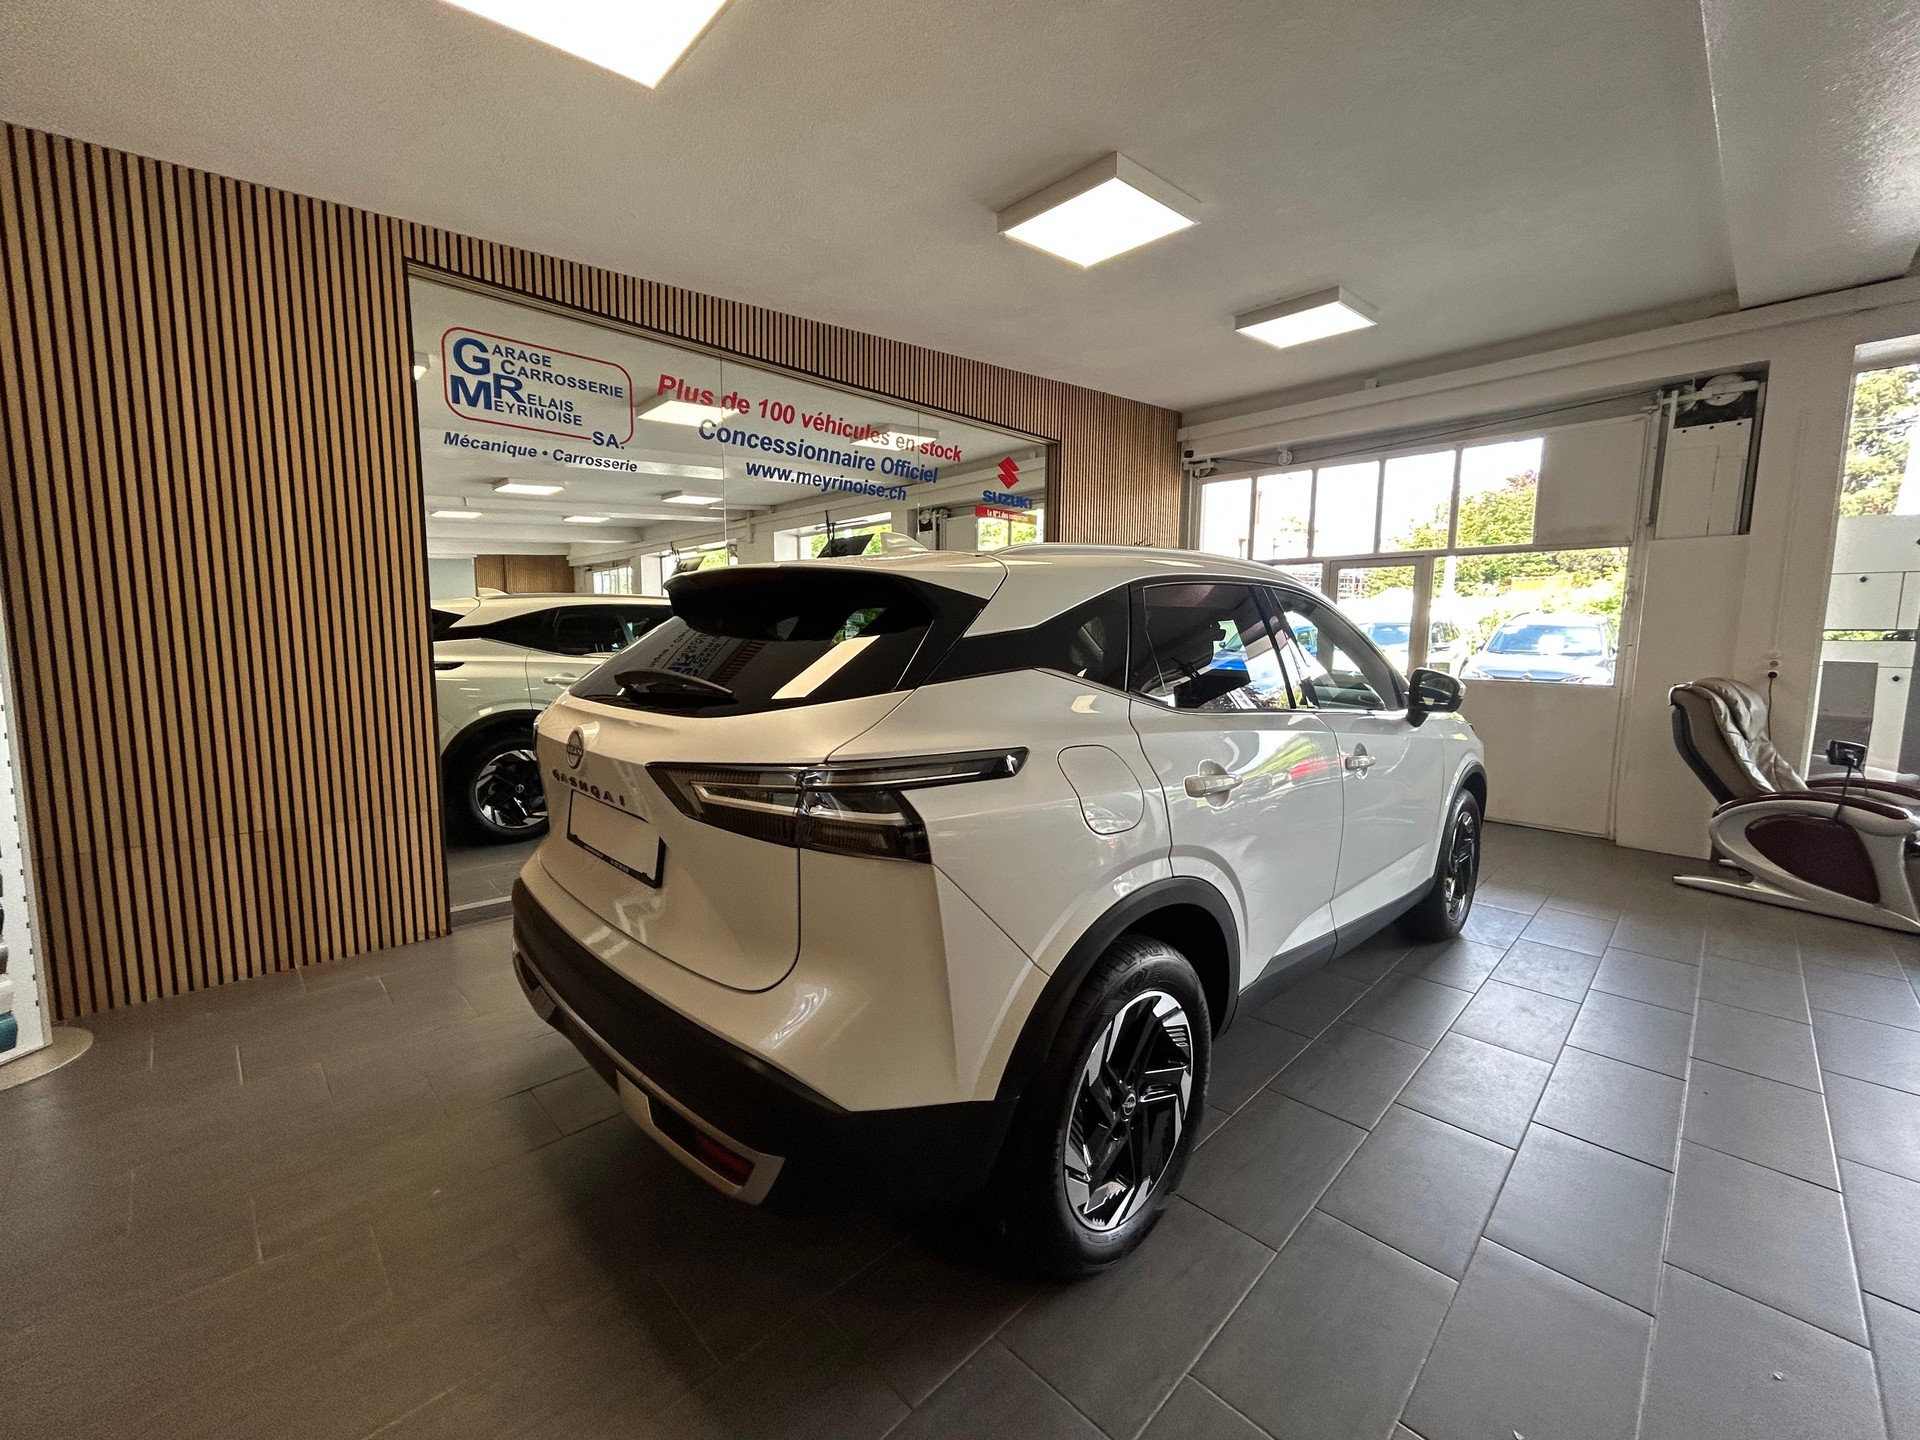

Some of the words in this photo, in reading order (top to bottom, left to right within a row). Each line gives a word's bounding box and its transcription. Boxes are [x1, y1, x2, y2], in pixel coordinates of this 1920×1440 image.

[453, 337, 552, 376] GARAGE
[492, 373, 574, 413] RELAIS
[500, 359, 624, 399] CARROSSERIE
[450, 374, 583, 427] MEYRINOISE
[657, 374, 714, 407] Plus
[720, 391, 750, 415] de
[758, 399, 796, 424] 100
[801, 411, 890, 446] véhicules
[895, 434, 915, 451] en
[919, 440, 963, 463] stock
[443, 431, 538, 458] Mécanique
[552, 449, 638, 473] Carrosserie
[698, 419, 877, 472] Concessionnaire
[880, 456, 939, 484] Officiel
[745, 461, 907, 501] www.meyrinoise.ch
[982, 489, 1033, 509] SUZUKI
[552, 768, 626, 807] QASHQAI
